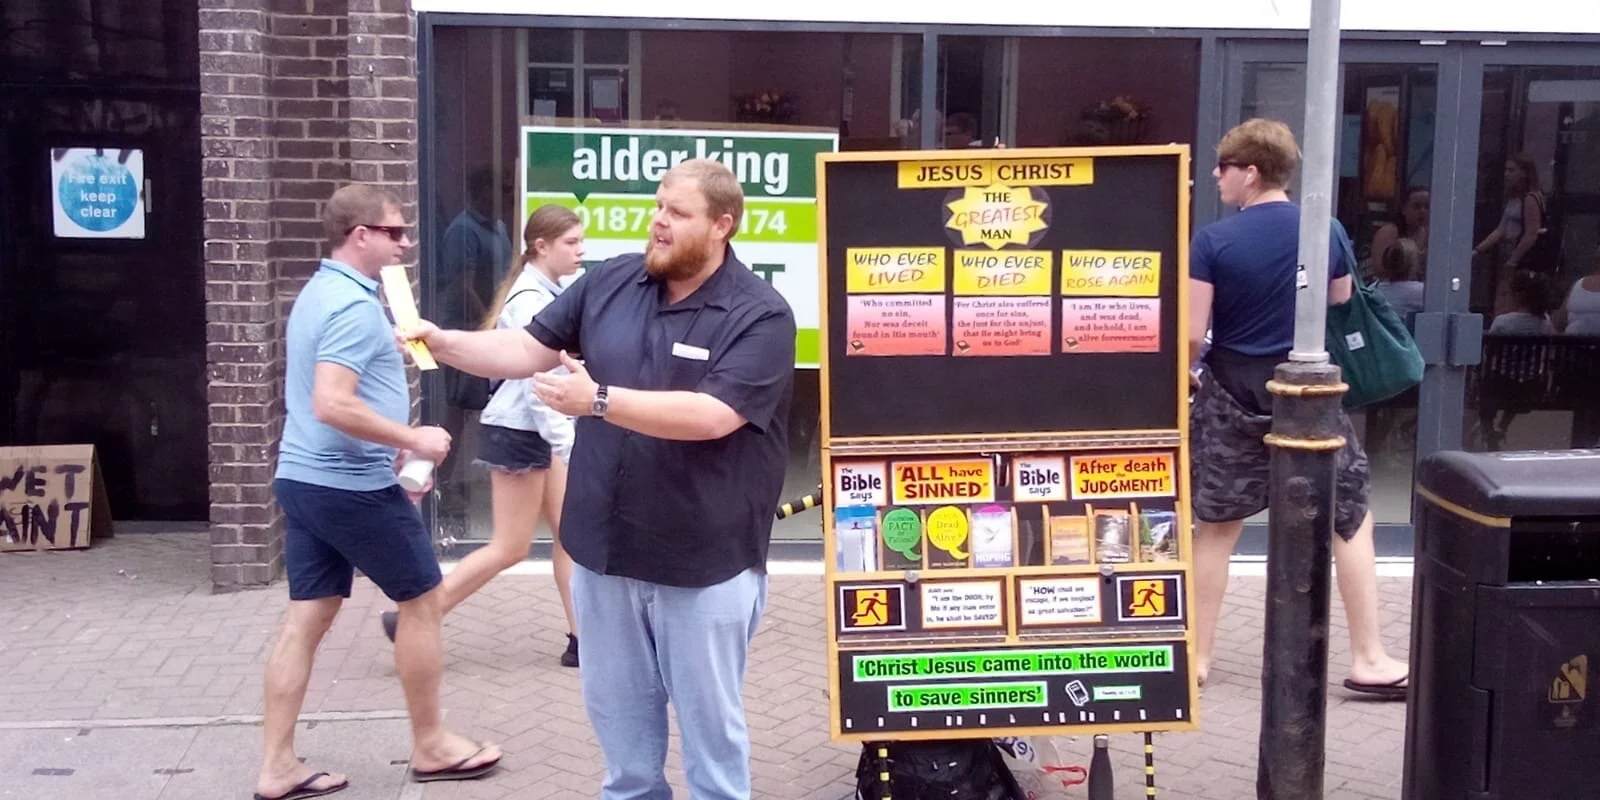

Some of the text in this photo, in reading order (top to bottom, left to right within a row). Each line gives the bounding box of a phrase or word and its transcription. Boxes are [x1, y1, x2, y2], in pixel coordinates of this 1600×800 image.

[572, 136, 688, 181] alder
[100, 173, 128, 185] exit
[917, 163, 1075, 182] JESUS CHRIST
[80, 190, 117, 205] keep
[983, 192, 1012, 203] THE
[80, 205, 118, 218] clear
[955, 205, 1040, 227] GREATEST
[980, 229, 1013, 240] MAN
[854, 253, 937, 266] WHO EVER
[961, 256, 1045, 269] WHO EVER
[1069, 256, 1153, 270] WHO EVER
[868, 269, 924, 287] LIVED
[977, 272, 1026, 288] DIED
[1066, 273, 1155, 288] ROSE AGAIN
[885, 299, 932, 307] committed
[998, 300, 1014, 308] also
[902, 320, 928, 328] deceit
[973, 320, 988, 329] just
[1074, 323, 1091, 331] and
[994, 330, 1018, 338] might
[1020, 330, 1042, 338] bring
[1079, 334, 1099, 342] alive
[949, 466, 983, 477] have
[1124, 457, 1166, 473] death
[841, 474, 881, 491] Bible
[1019, 469, 1060, 486] Bible
[850, 492, 873, 502] says
[1029, 487, 1051, 497] says
[888, 521, 914, 531] FACT
[936, 520, 959, 529] Dead
[859, 650, 1166, 676] 'Christ Jesus came into the world
[895, 685, 1042, 706] to save sinners'
